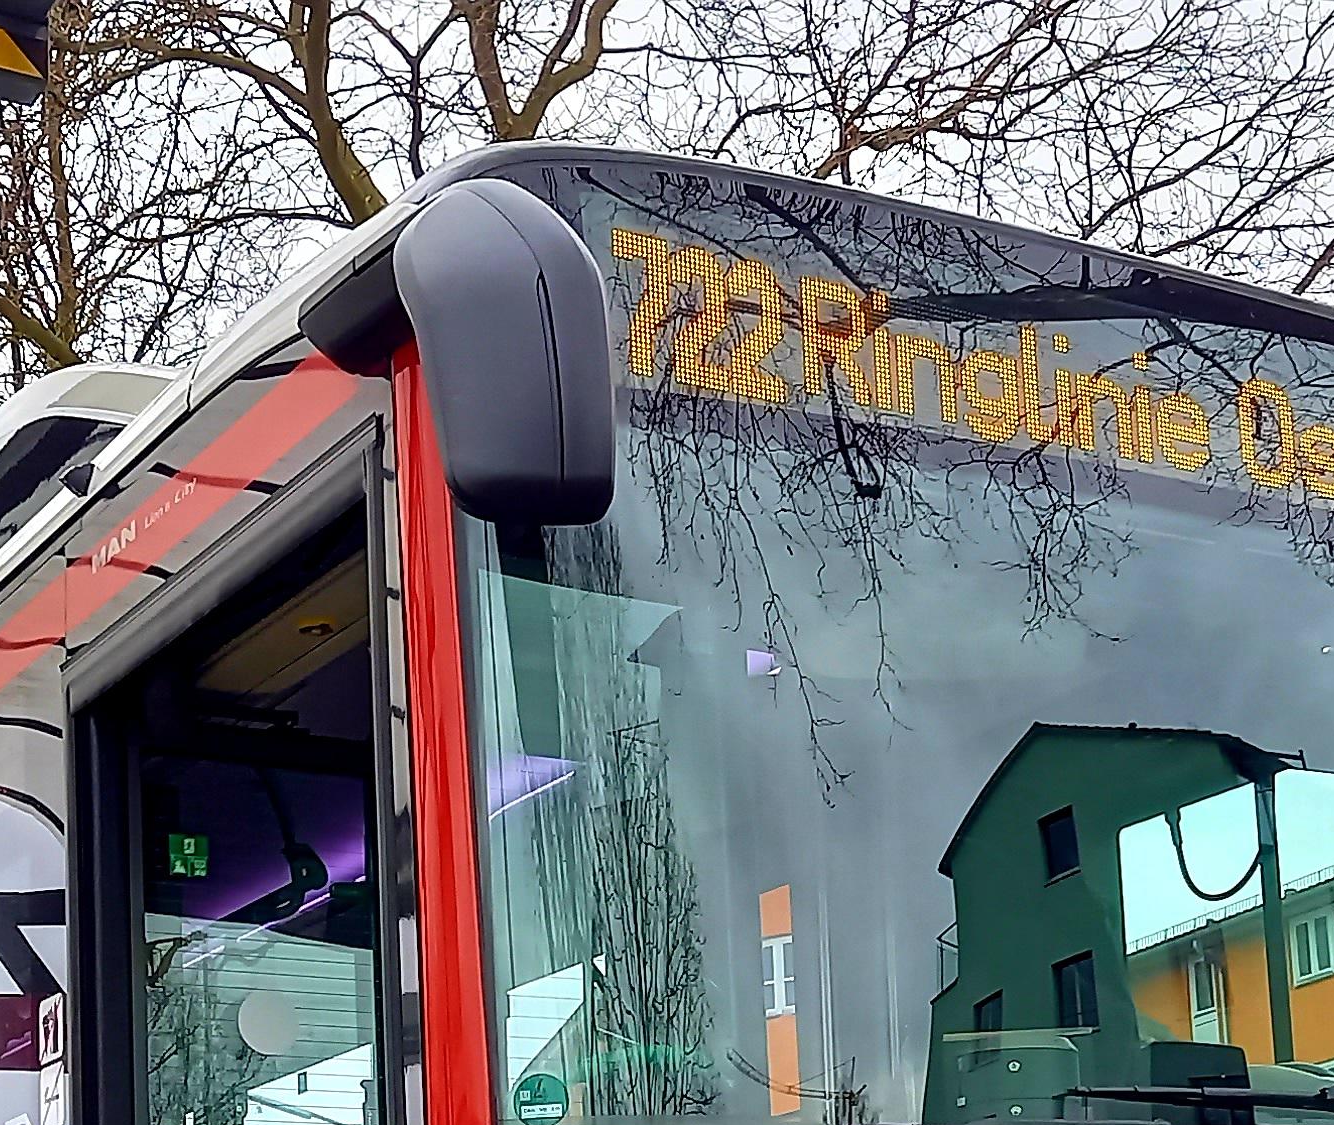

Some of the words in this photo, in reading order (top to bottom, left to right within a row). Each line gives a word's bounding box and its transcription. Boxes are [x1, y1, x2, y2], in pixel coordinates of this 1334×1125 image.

[612, 228, 788, 404] 722
[799, 276, 1211, 473] Ringlinie
[91, 519, 137, 575] MAN
